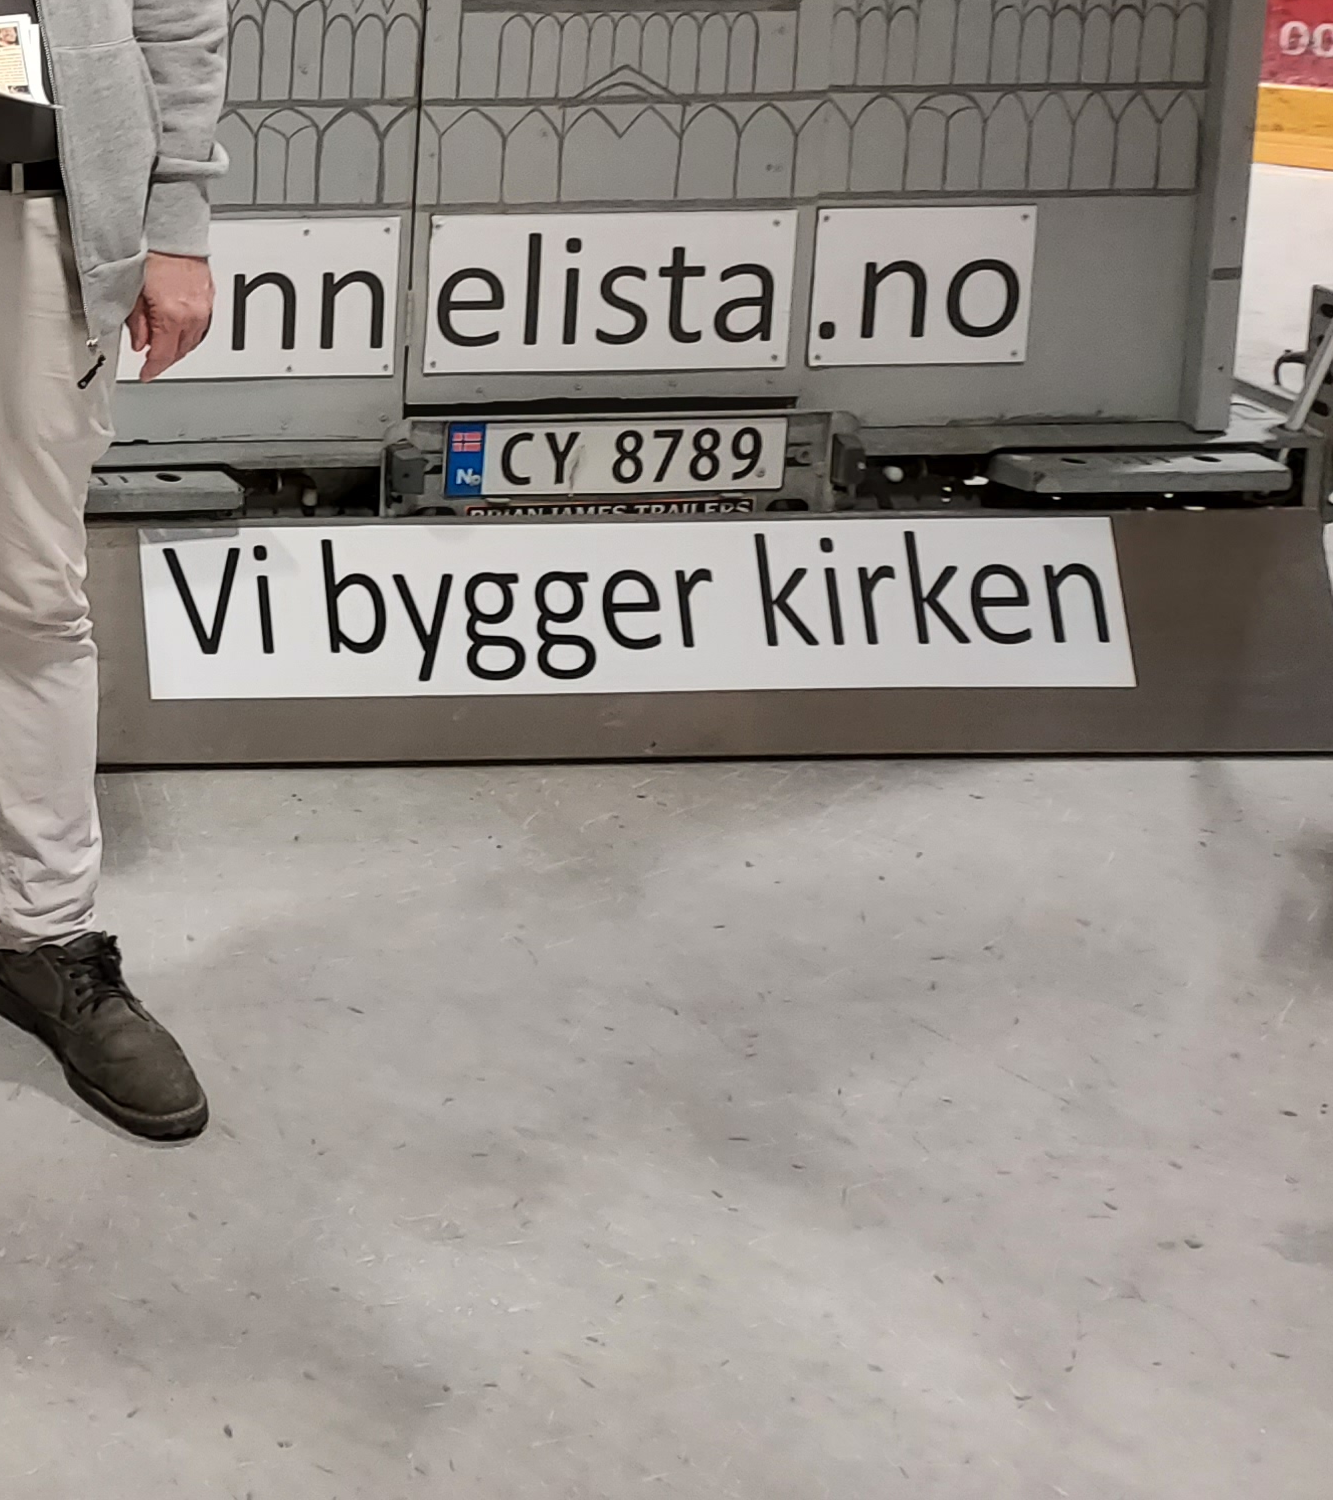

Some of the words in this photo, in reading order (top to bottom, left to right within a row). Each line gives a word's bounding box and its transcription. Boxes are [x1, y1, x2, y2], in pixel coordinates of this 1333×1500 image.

[231, 270, 385, 351] nn
[500, 431, 582, 486] CY
[611, 426, 764, 485] 8789
[163, 543, 275, 656] Vi
[320, 538, 713, 682] bygger
[754, 531, 1111, 648] kirken
